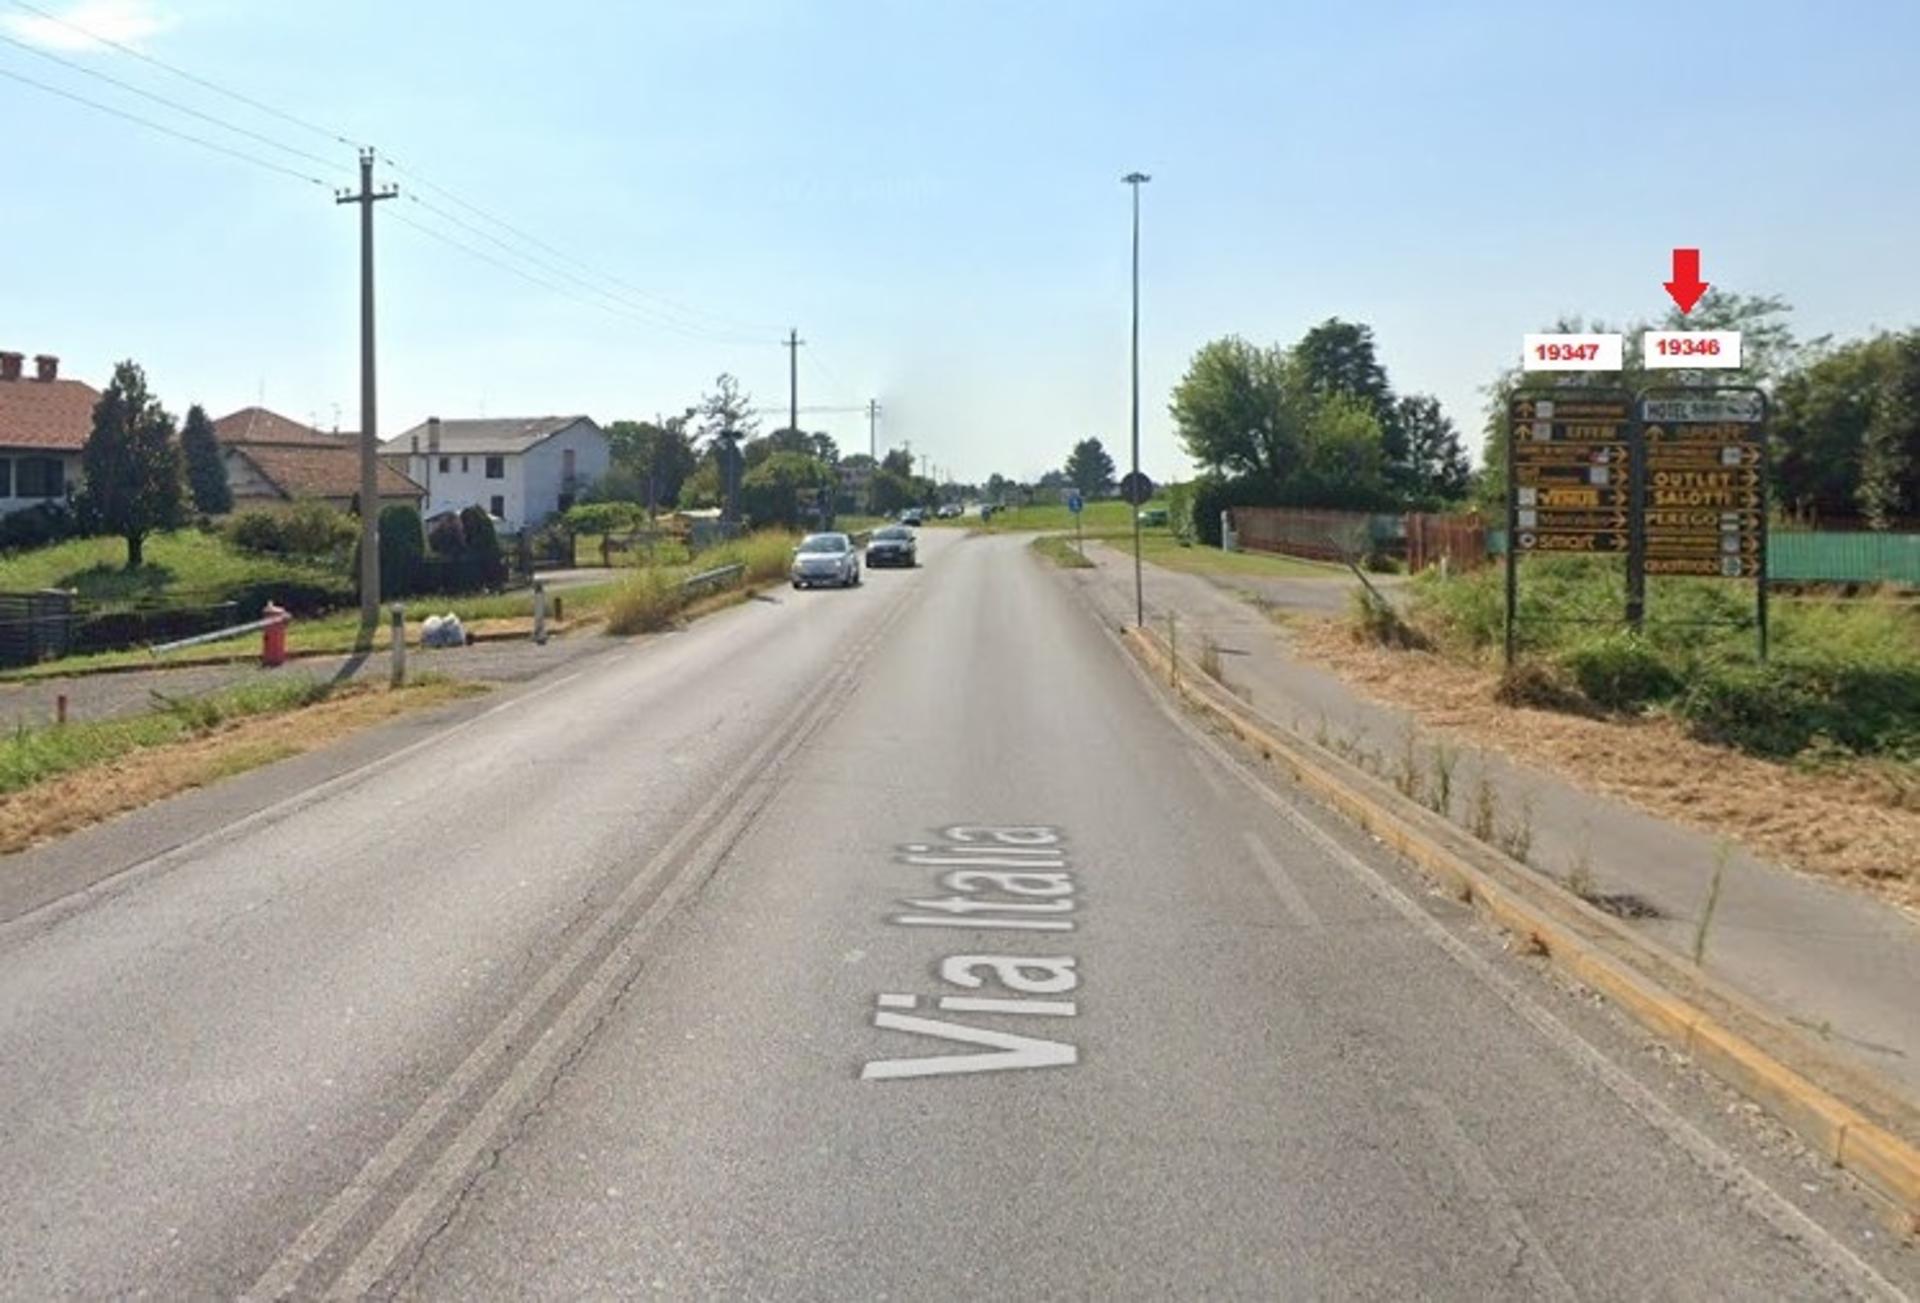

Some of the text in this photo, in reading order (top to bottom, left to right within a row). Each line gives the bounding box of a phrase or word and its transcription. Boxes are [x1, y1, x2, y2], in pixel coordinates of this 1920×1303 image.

[1653, 471, 1731, 487] OUTLET
[1653, 489, 1733, 505] SALOTTI
[1644, 512, 1718, 526] PEREGO
[1538, 534, 1595, 550] smart
